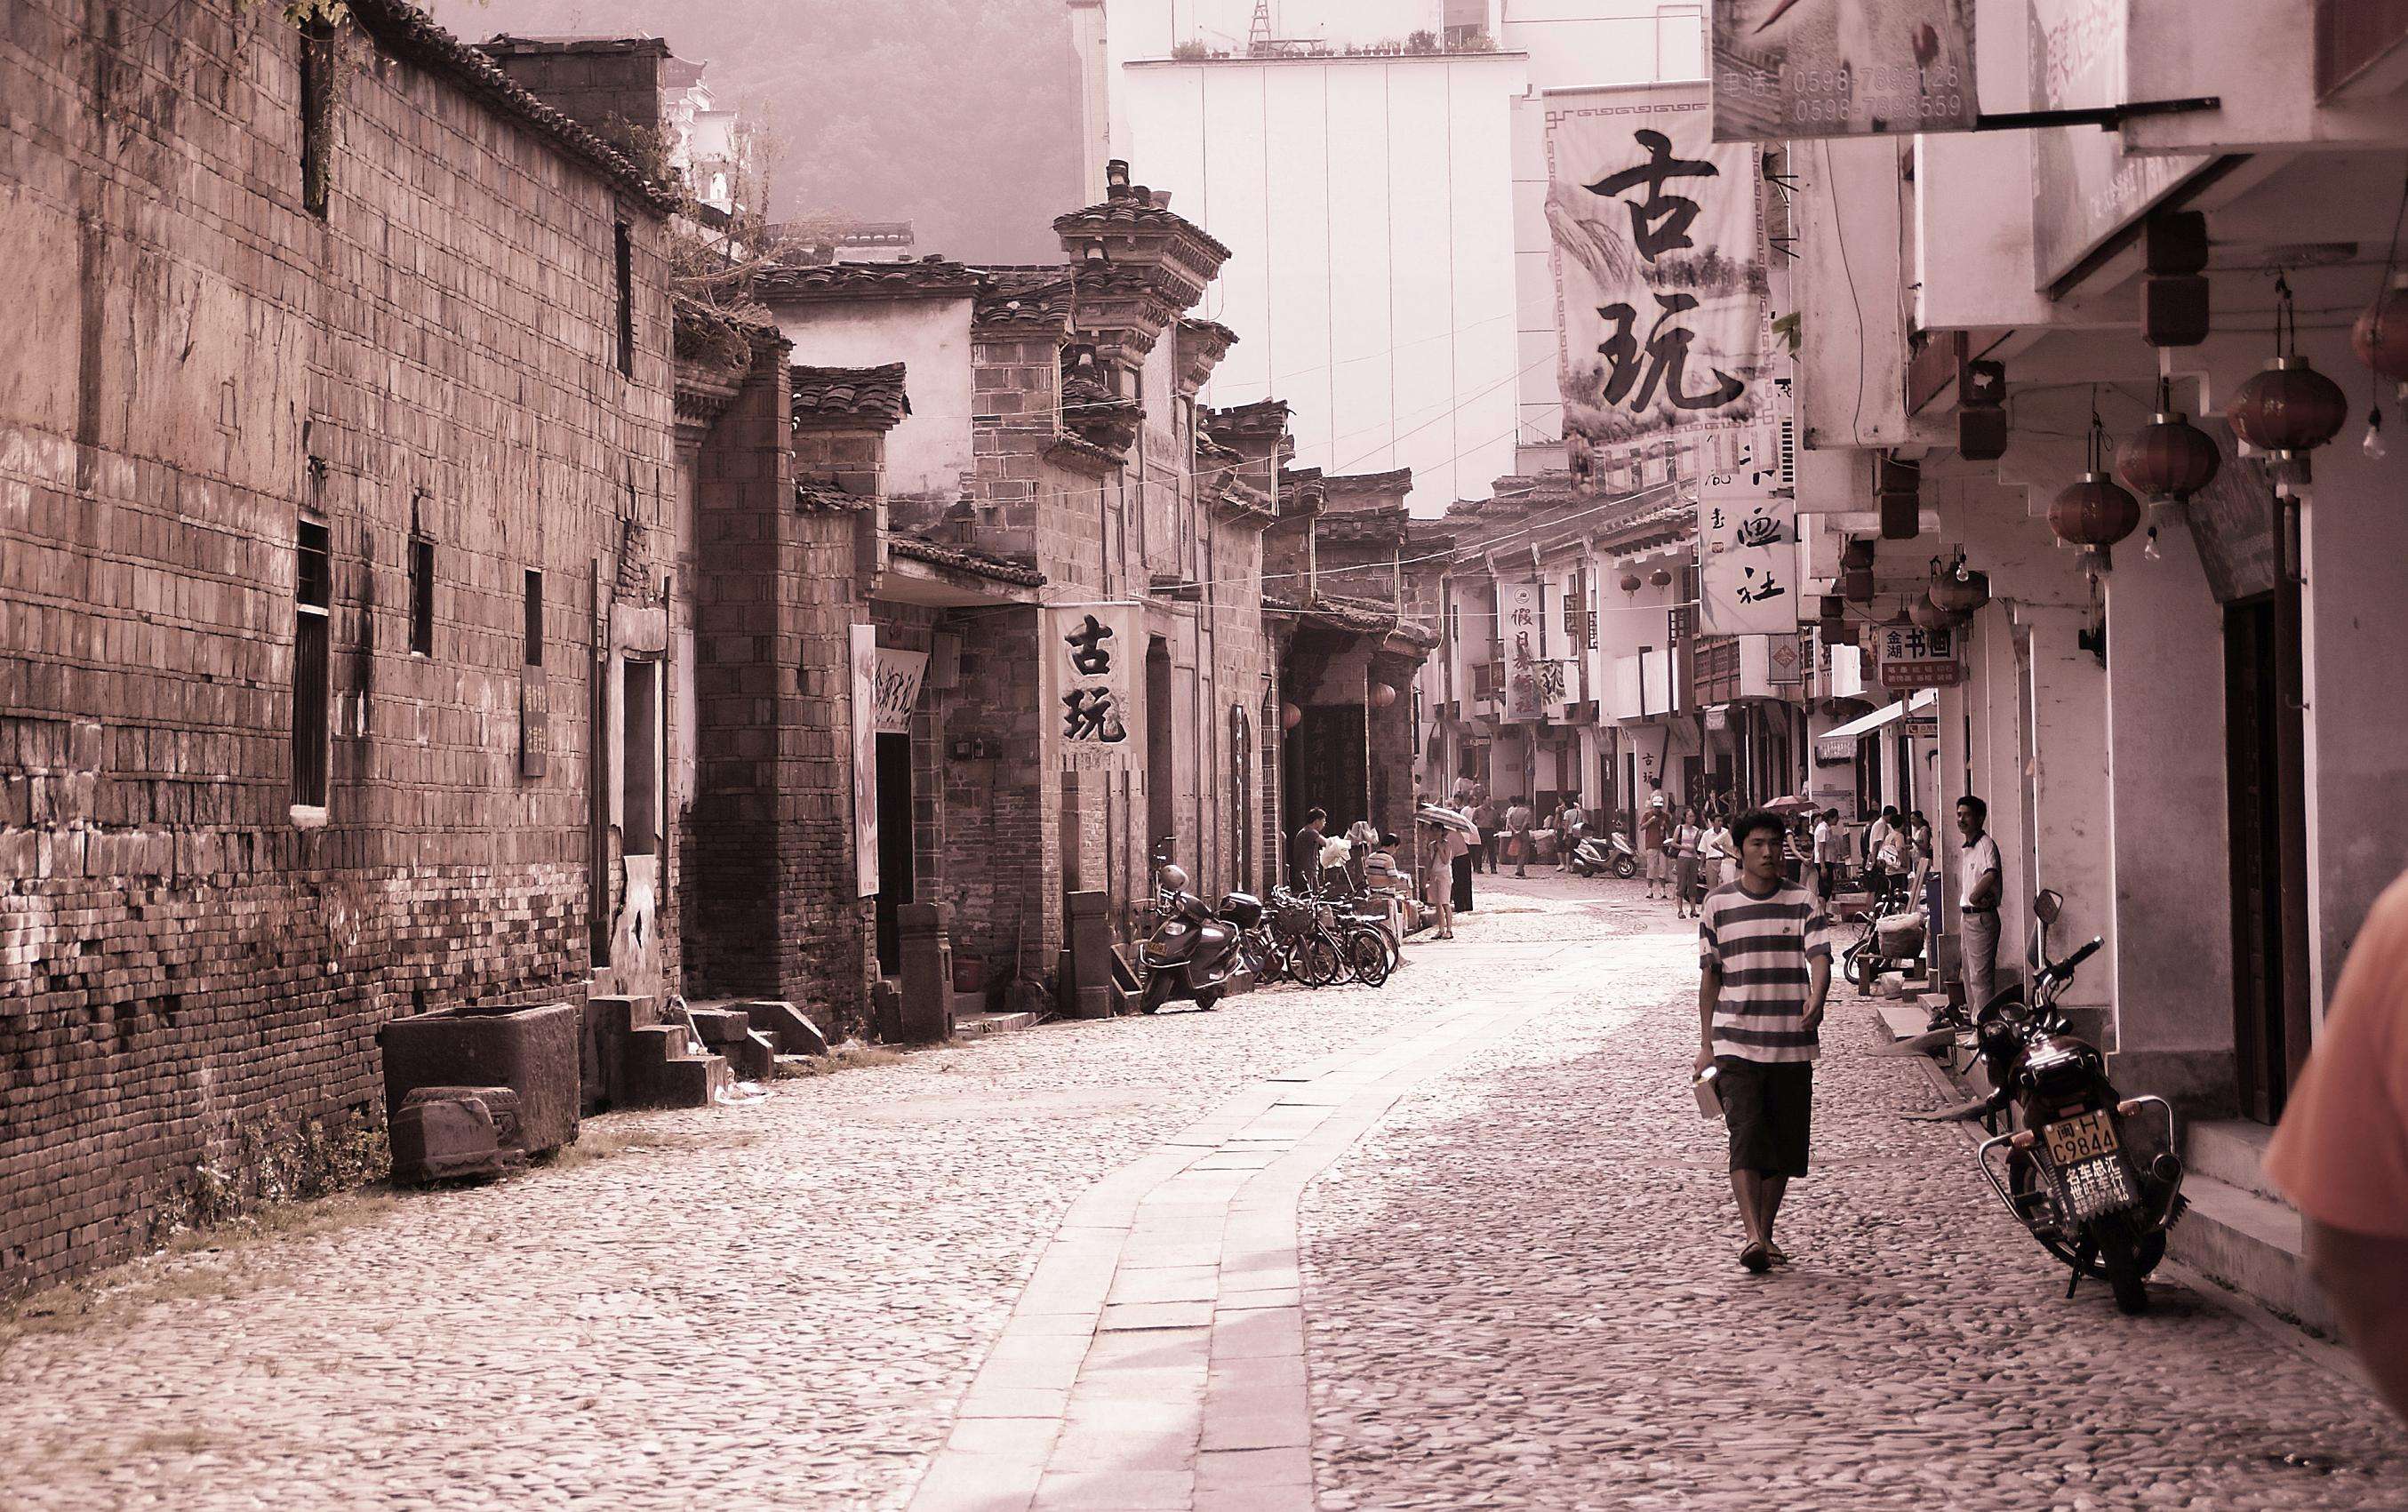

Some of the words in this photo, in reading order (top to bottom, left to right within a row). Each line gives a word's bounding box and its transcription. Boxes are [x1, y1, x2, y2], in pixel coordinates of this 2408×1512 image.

[1581, 128, 1745, 413] 古玩
[1887, 630, 1902, 658] 金湖
[1061, 613, 1127, 743] 古玩
[2053, 1130, 2114, 1163] C9844
[2066, 1156, 2121, 1187] 名车总汇
